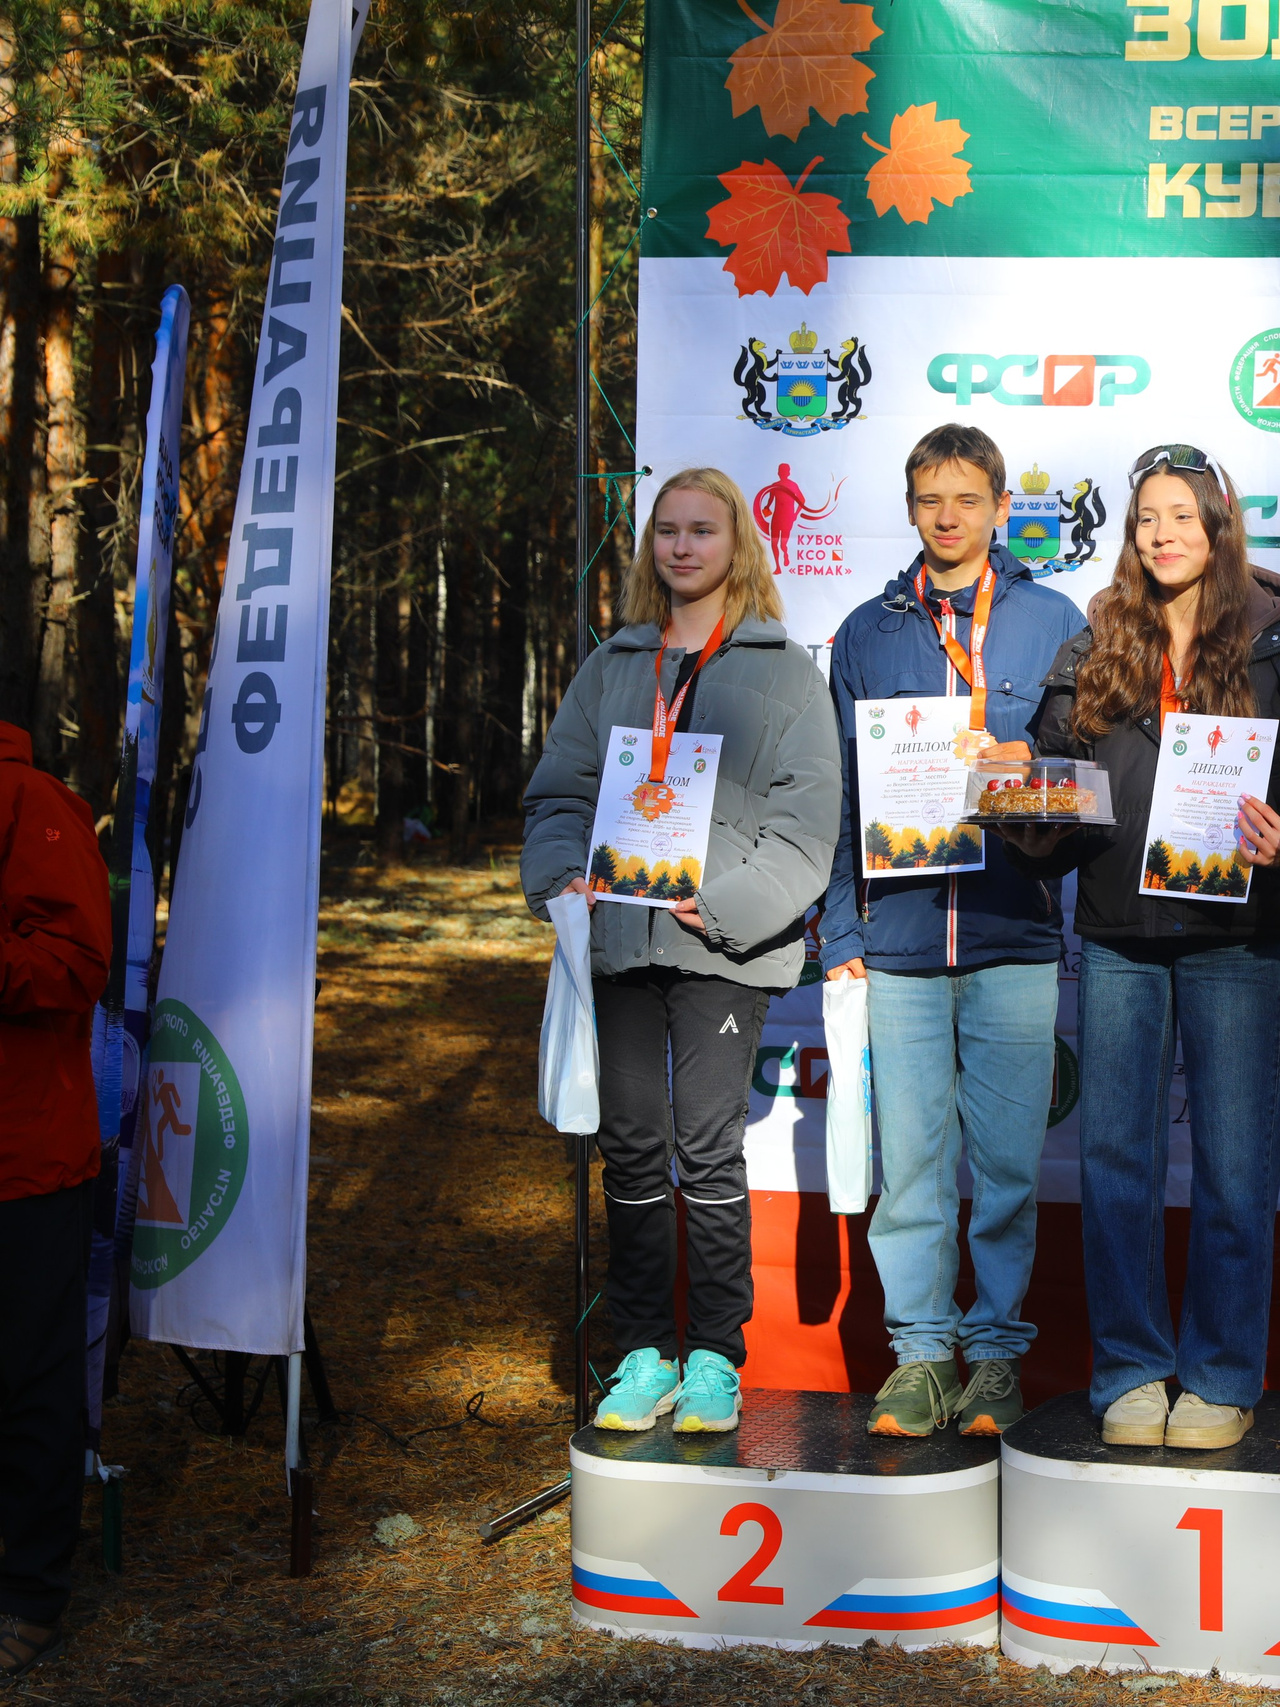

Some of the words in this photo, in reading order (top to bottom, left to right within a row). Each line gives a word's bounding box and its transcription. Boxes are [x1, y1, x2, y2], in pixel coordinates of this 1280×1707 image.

[797, 534, 843, 546] КУБОК
[797, 549, 826, 561] КСО
[788, 564, 852, 576] «ЕРМАК»
[981, 566, 993, 593] ТЮМЕН
[891, 741, 952, 756] ДИПЛОМ
[1187, 762, 1244, 777] ДИПЛОМ
[657, 788, 668, 799] 2
[717, 1502, 785, 1605] 2
[1175, 1507, 1224, 1632] 1
